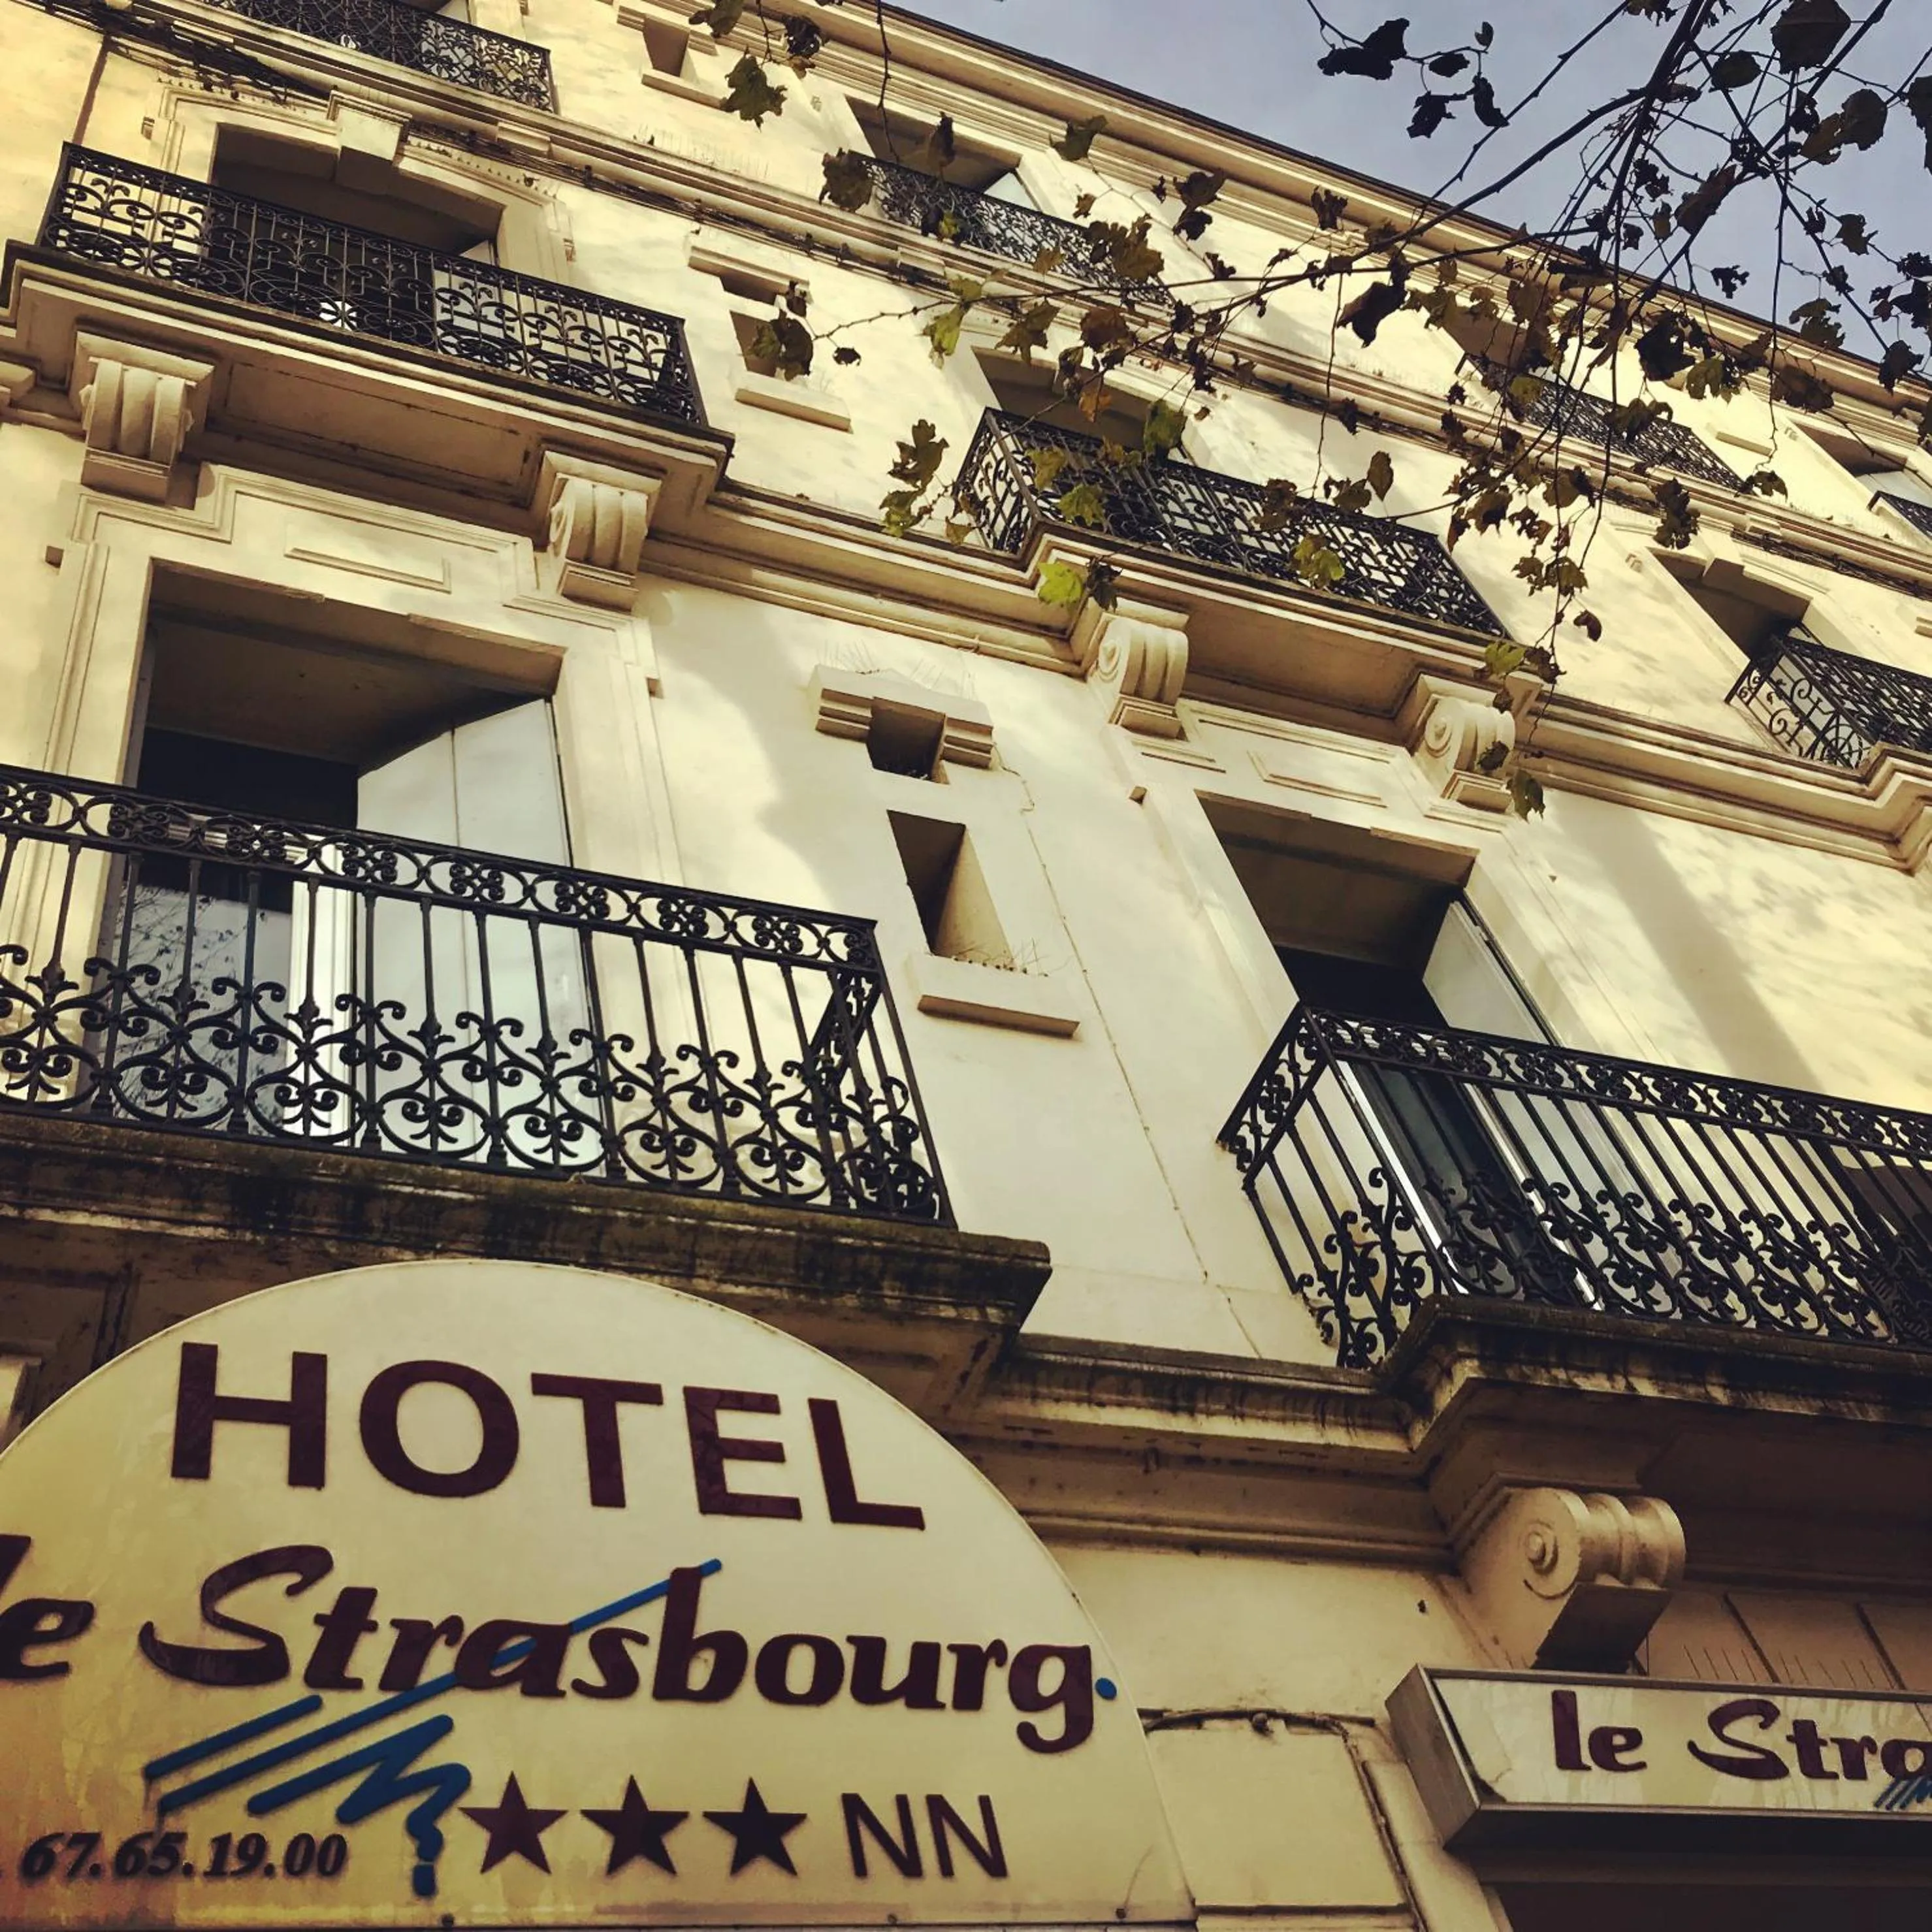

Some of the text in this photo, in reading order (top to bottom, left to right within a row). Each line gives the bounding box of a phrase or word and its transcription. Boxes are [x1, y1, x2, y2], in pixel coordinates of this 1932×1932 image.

[171, 1341, 926, 1531] HOTEL
[138, 1544, 1095, 1754] Strasbourg
[1551, 1689, 1932, 1782] le Stra
[20, 1831, 349, 1882] 67.65.19.00
[841, 1792, 1008, 1880] NN
